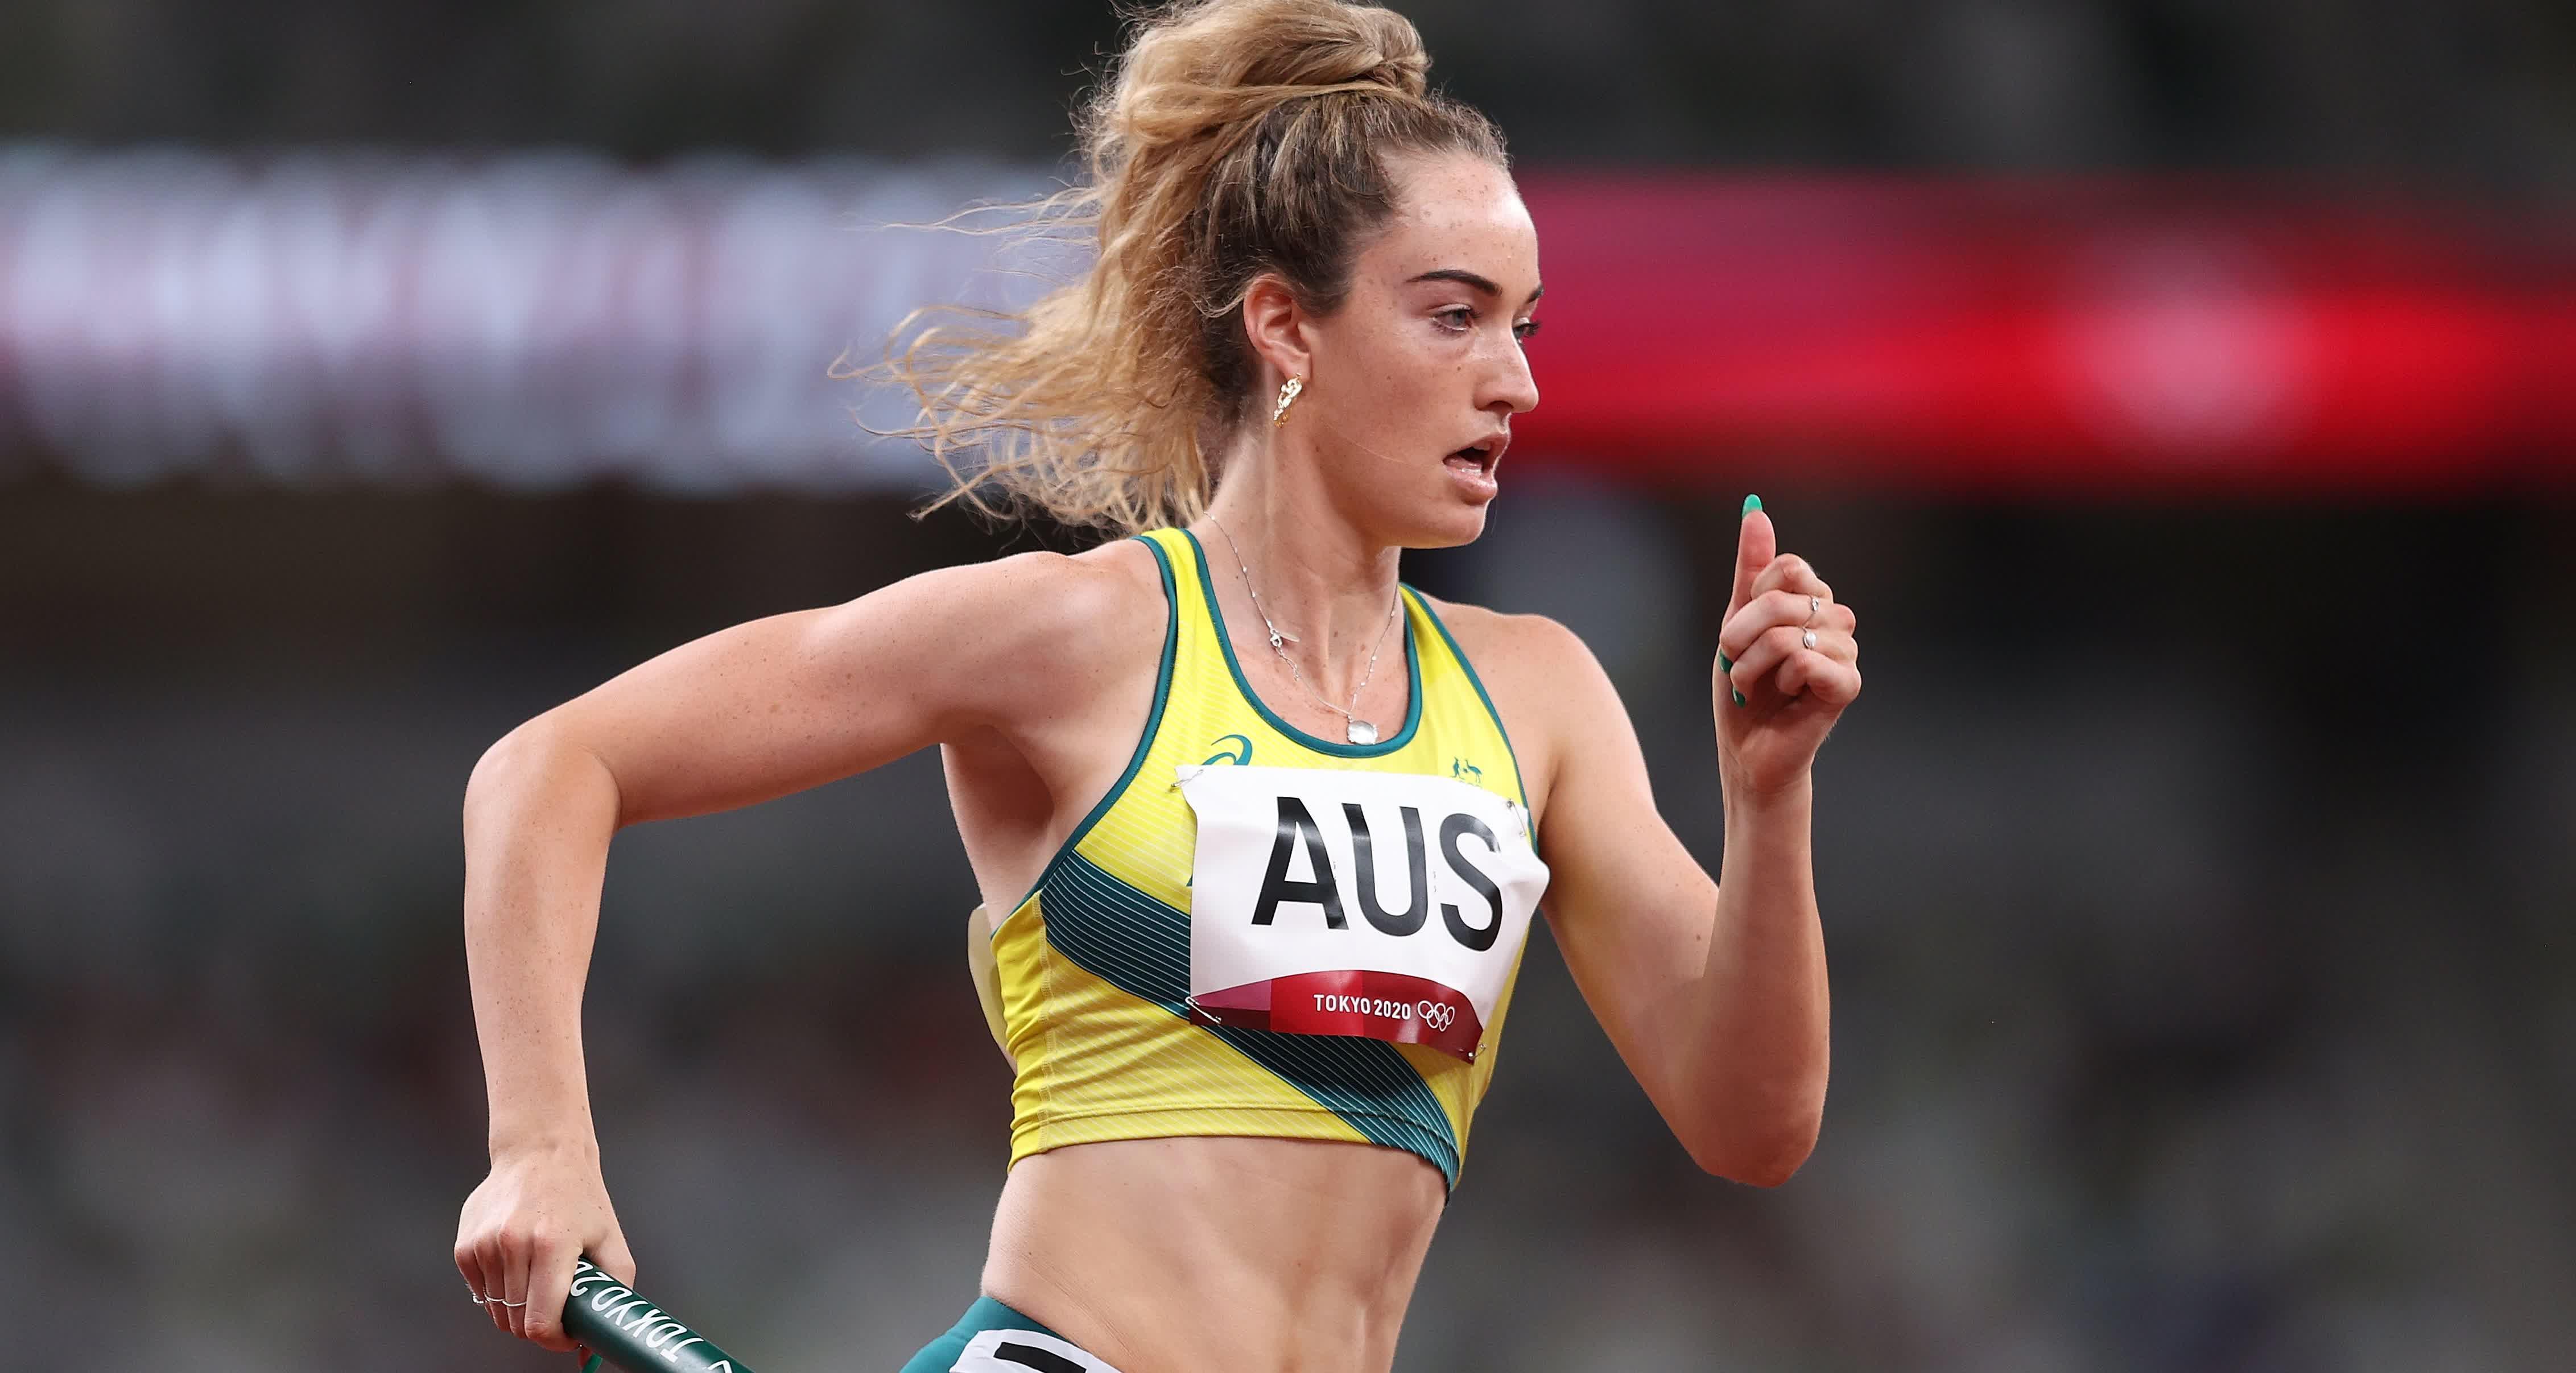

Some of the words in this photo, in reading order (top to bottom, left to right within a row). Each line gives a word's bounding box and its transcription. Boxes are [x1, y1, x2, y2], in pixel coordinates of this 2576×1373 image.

[1251, 796, 1504, 952] AUS
[1313, 994, 1371, 1015] TOKYO
[1373, 999, 1411, 1020] 2020
[591, 1286, 704, 1363] TOKYO
